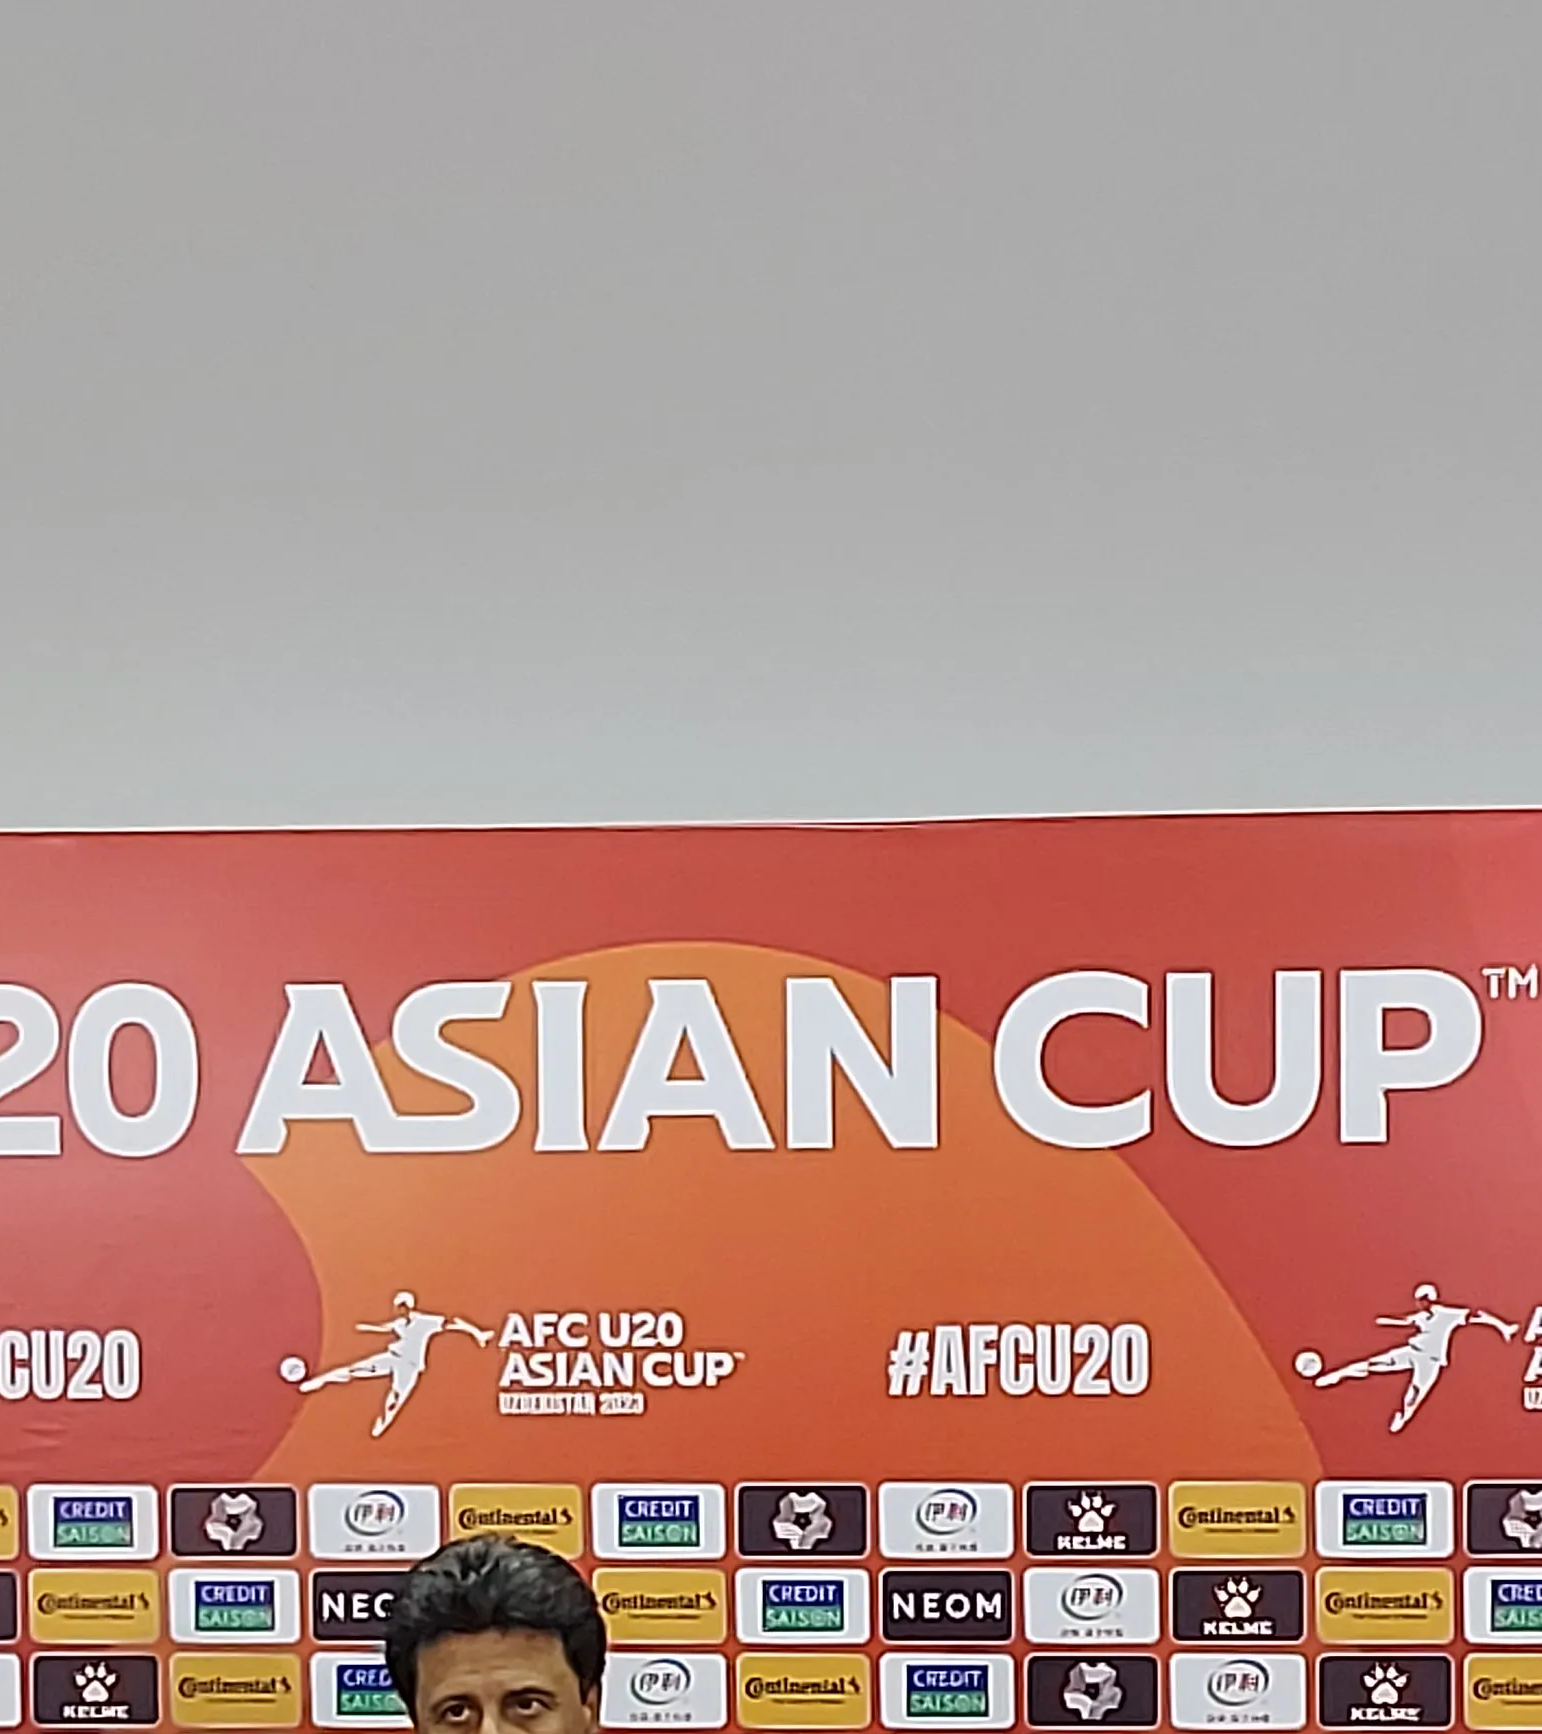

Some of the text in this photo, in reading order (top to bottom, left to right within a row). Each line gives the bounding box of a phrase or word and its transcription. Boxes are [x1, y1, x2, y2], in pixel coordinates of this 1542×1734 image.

[236, 977, 937, 1153] ASIAN
[994, 969, 1484, 1148] CUP
[498, 1312, 683, 1347] AFC U20
[889, 1324, 1148, 1395] #AFCU20
[499, 1352, 735, 1387] ASIAN CUP
[59, 1502, 127, 1519] CREDIT
[624, 1500, 693, 1518] CREDIT
[1349, 1498, 1420, 1516] CREDIT
[200, 1586, 268, 1603] CREDIT
[768, 1585, 838, 1603] CREDIT
[893, 1593, 1001, 1619] NEOM
[912, 1670, 982, 1688] CREDIT
